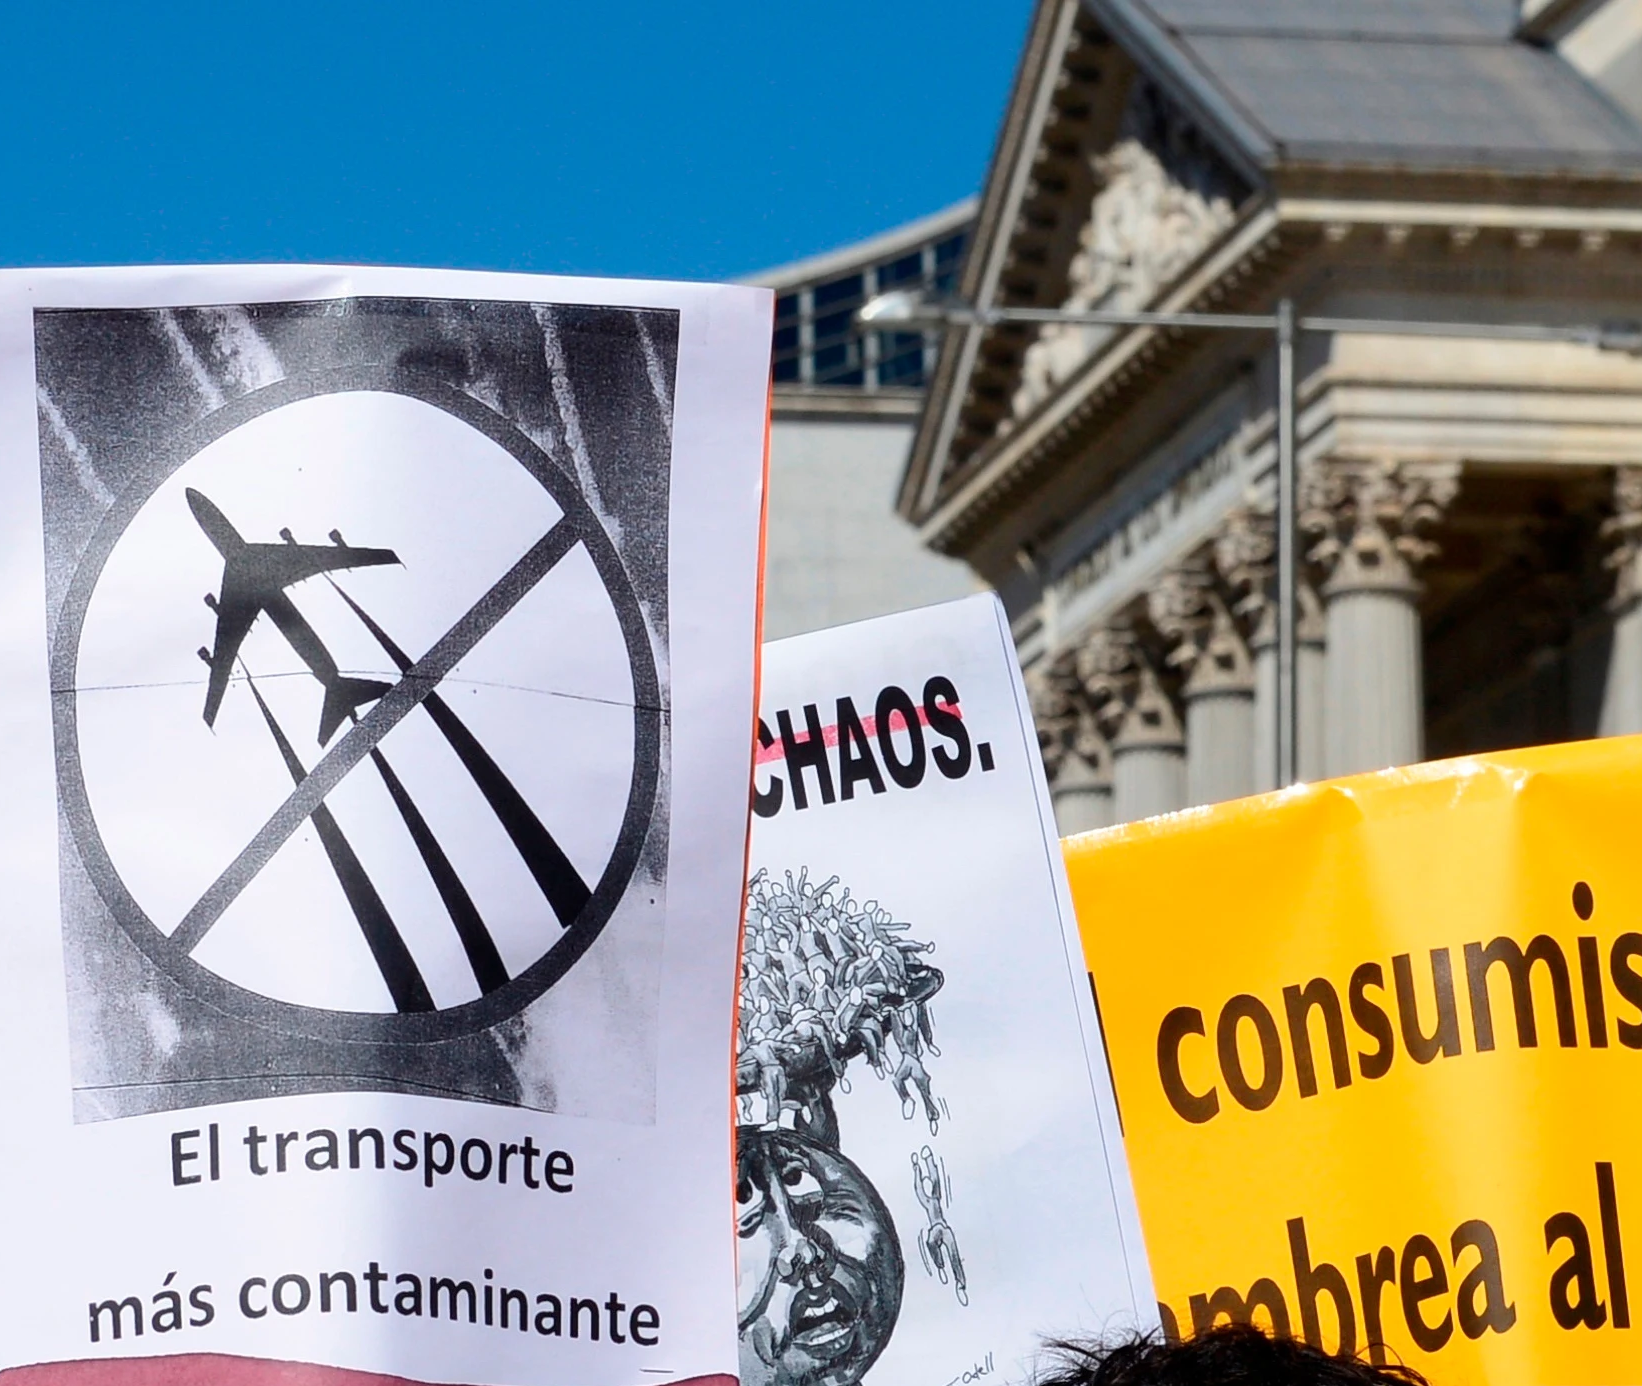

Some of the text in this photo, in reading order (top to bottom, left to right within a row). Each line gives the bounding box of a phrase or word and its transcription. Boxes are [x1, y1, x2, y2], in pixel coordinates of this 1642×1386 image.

[753, 675, 996, 818] CHAOS.
[171, 1123, 575, 1193] El transporte
[1544, 1161, 1631, 1331] al
[89, 1261, 660, 1346] más contaminante
